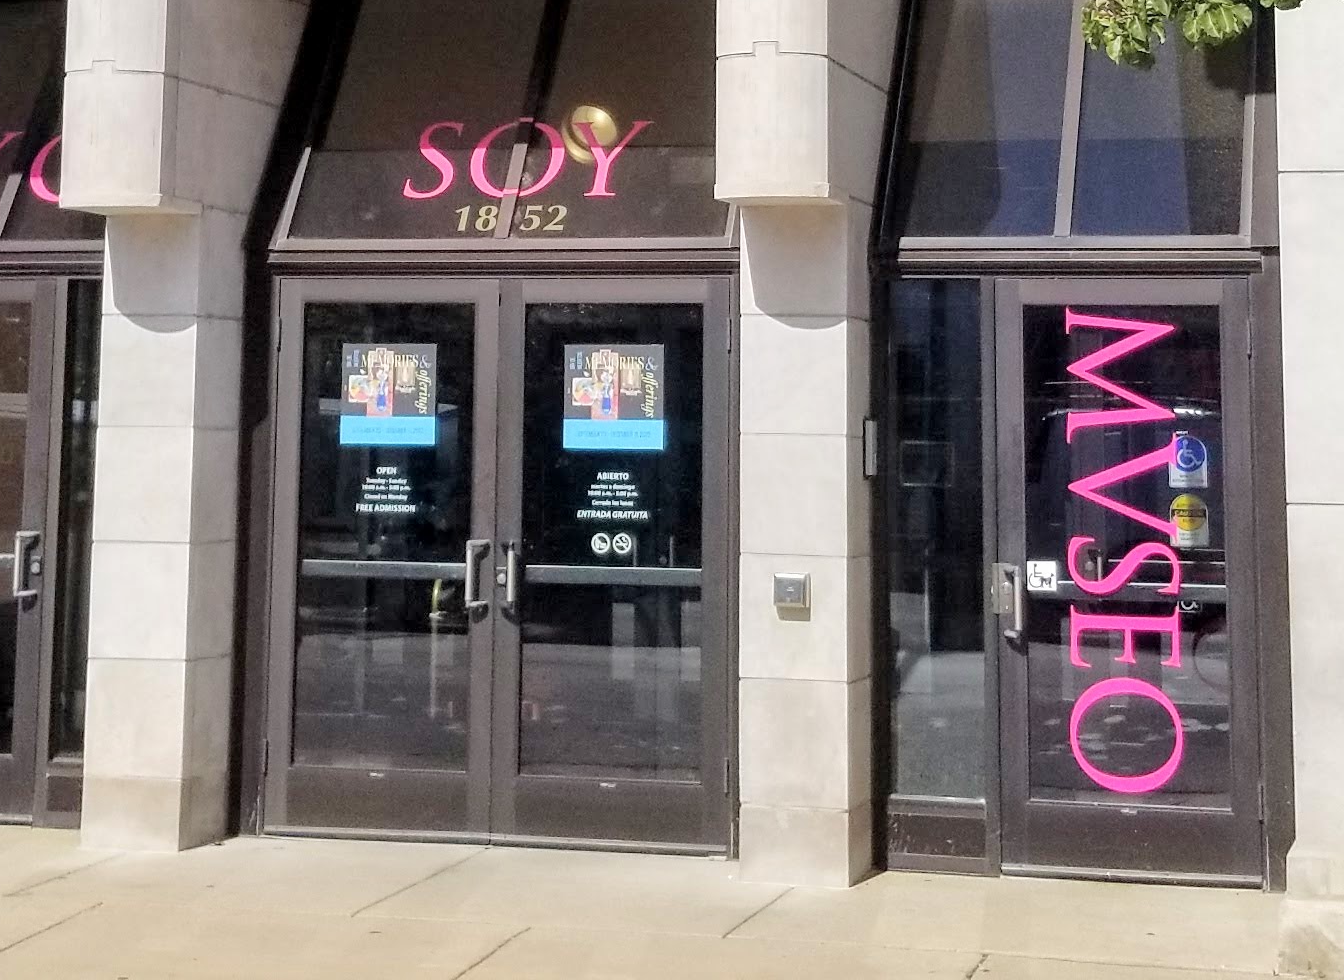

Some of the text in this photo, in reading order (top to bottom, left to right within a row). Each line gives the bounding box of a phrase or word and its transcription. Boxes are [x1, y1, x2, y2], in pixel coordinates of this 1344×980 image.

[402, 117, 655, 200] SOY
[454, 204, 568, 232] 1852
[376, 466, 397, 475] OPEN
[596, 471, 630, 481] ABIERTO
[356, 503, 416, 513] FREE ADMISSION
[576, 509, 649, 520] ENTRADA GRATUITA
[1064, 306, 1184, 794] MVSEO
